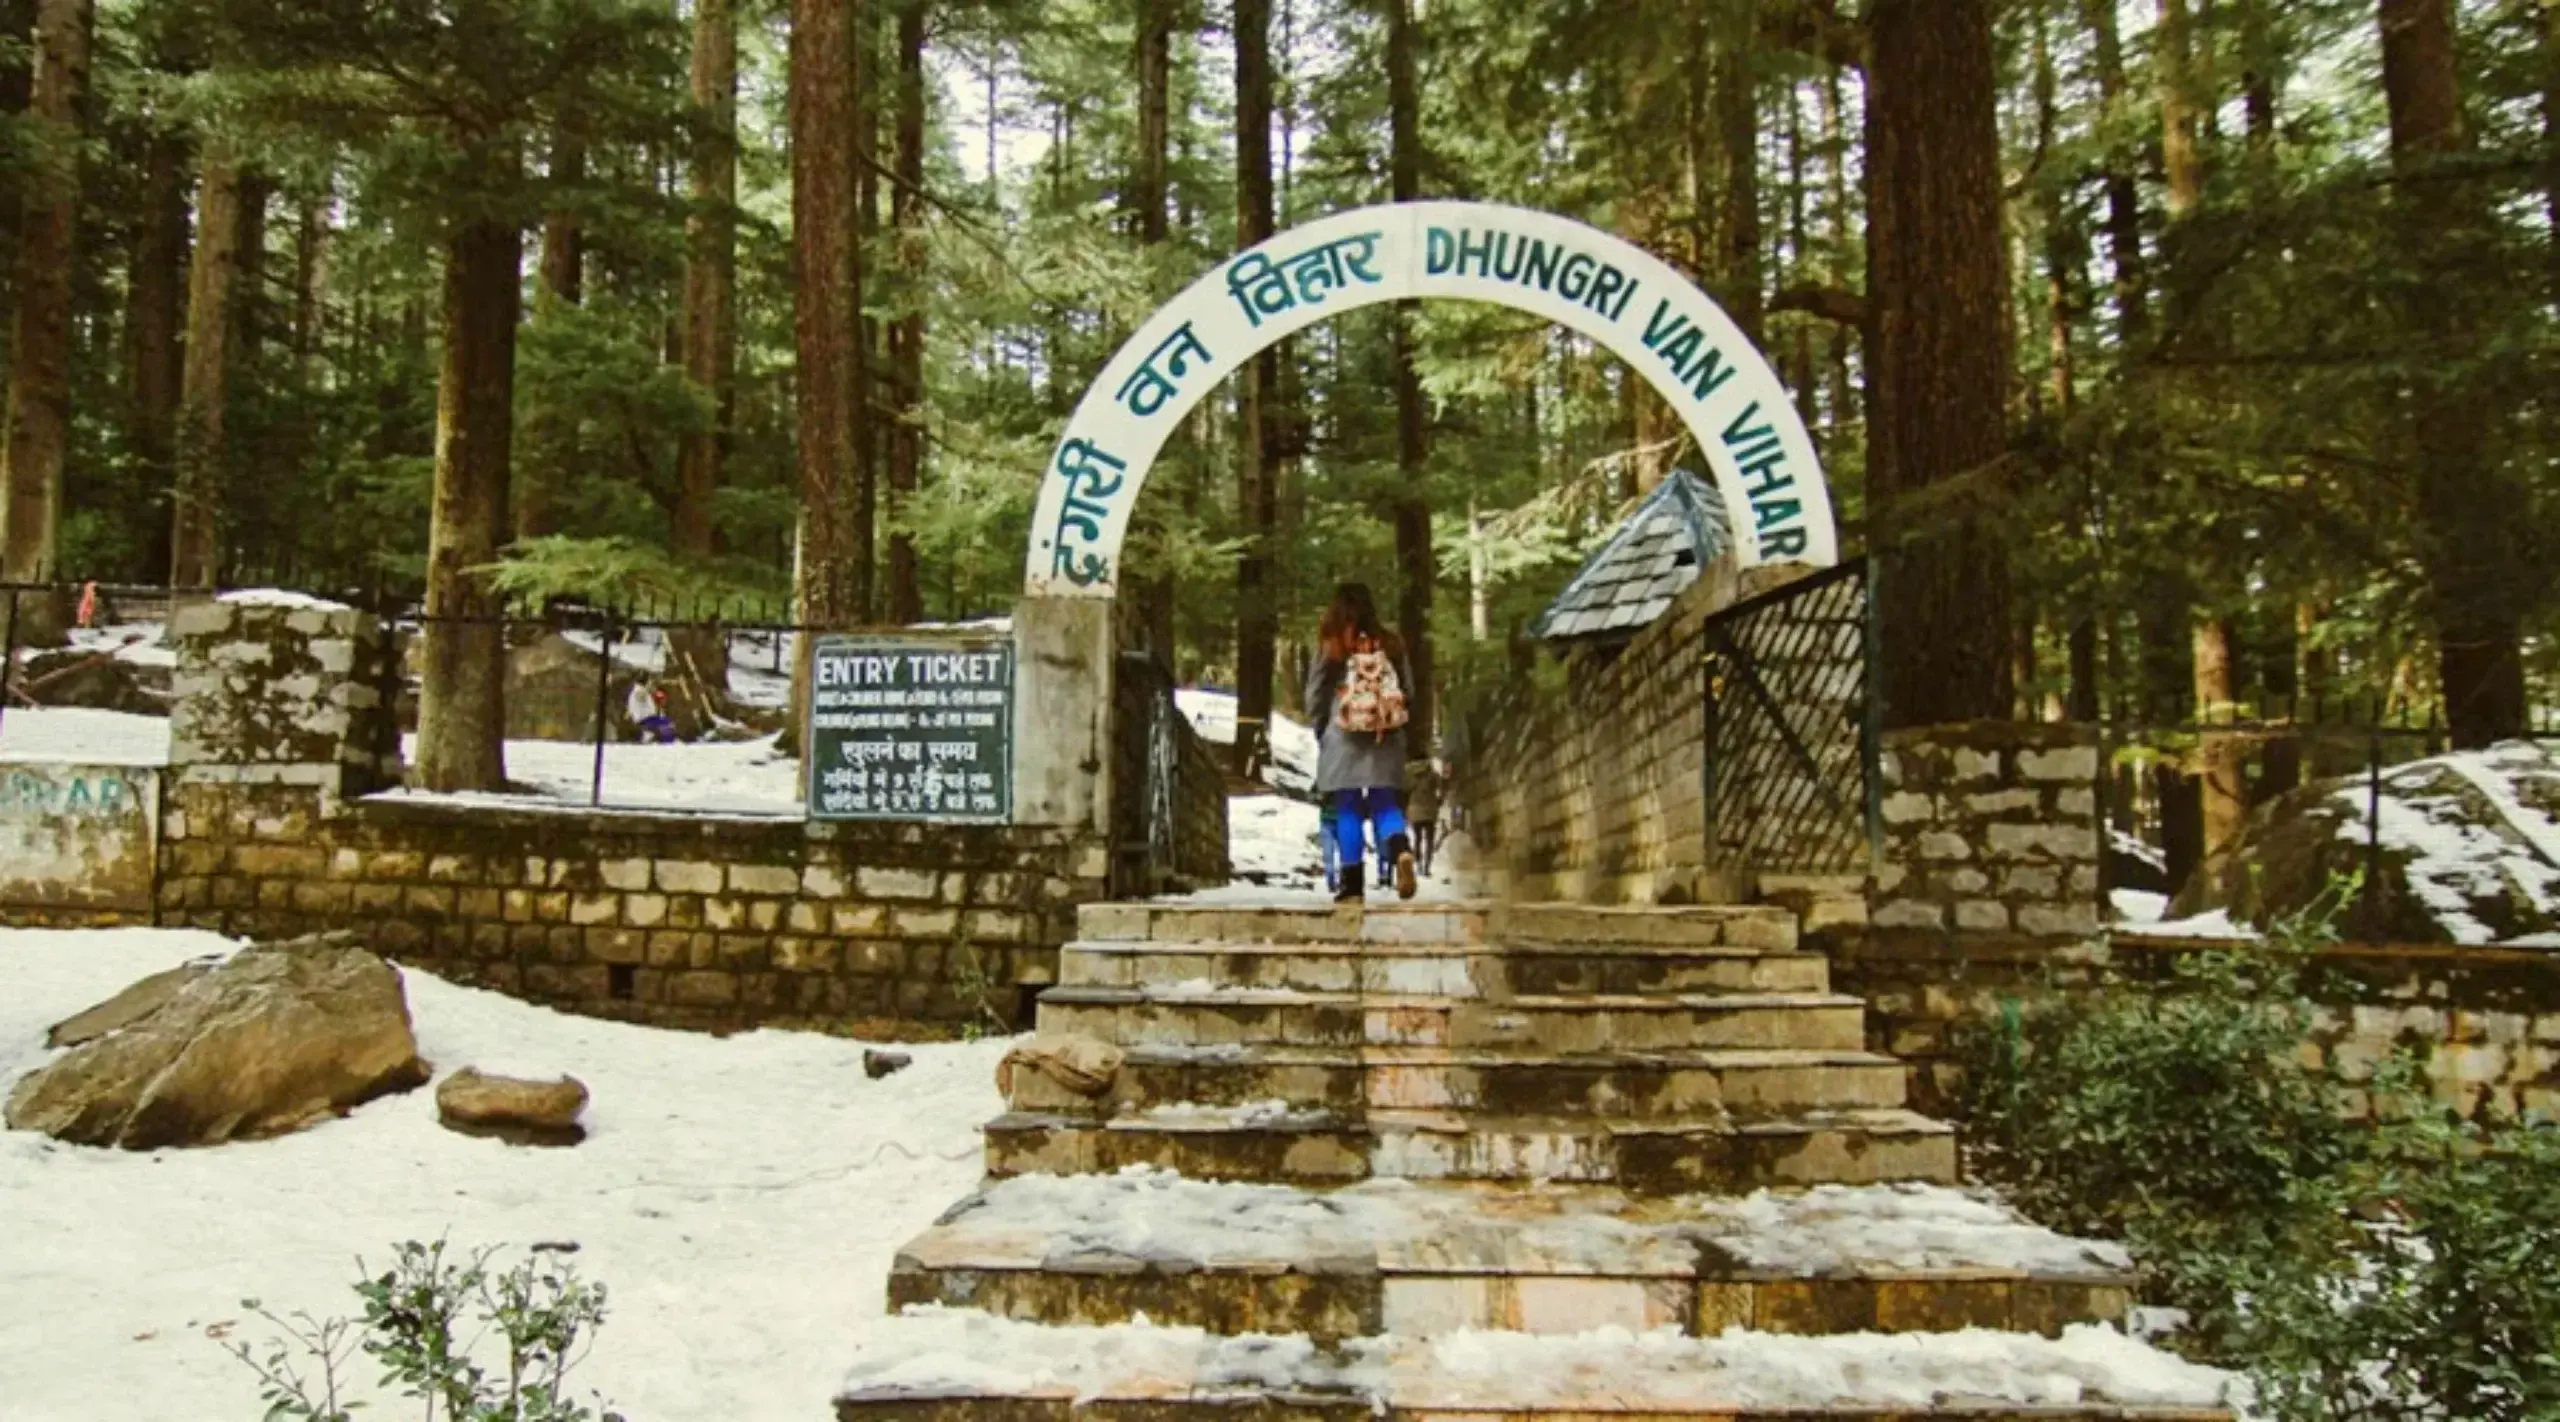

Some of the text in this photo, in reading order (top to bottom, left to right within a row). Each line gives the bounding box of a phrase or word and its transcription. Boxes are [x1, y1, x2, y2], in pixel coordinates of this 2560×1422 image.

[1115, 320, 1214, 417] वन
[1227, 232, 1383, 328] विहार
[1426, 226, 1808, 562] DHUNGRI VAN VIHAR
[819, 653, 1001, 685] ENTRY TICKET
[898, 741, 922, 761] का
[927, 741, 979, 763] समय
